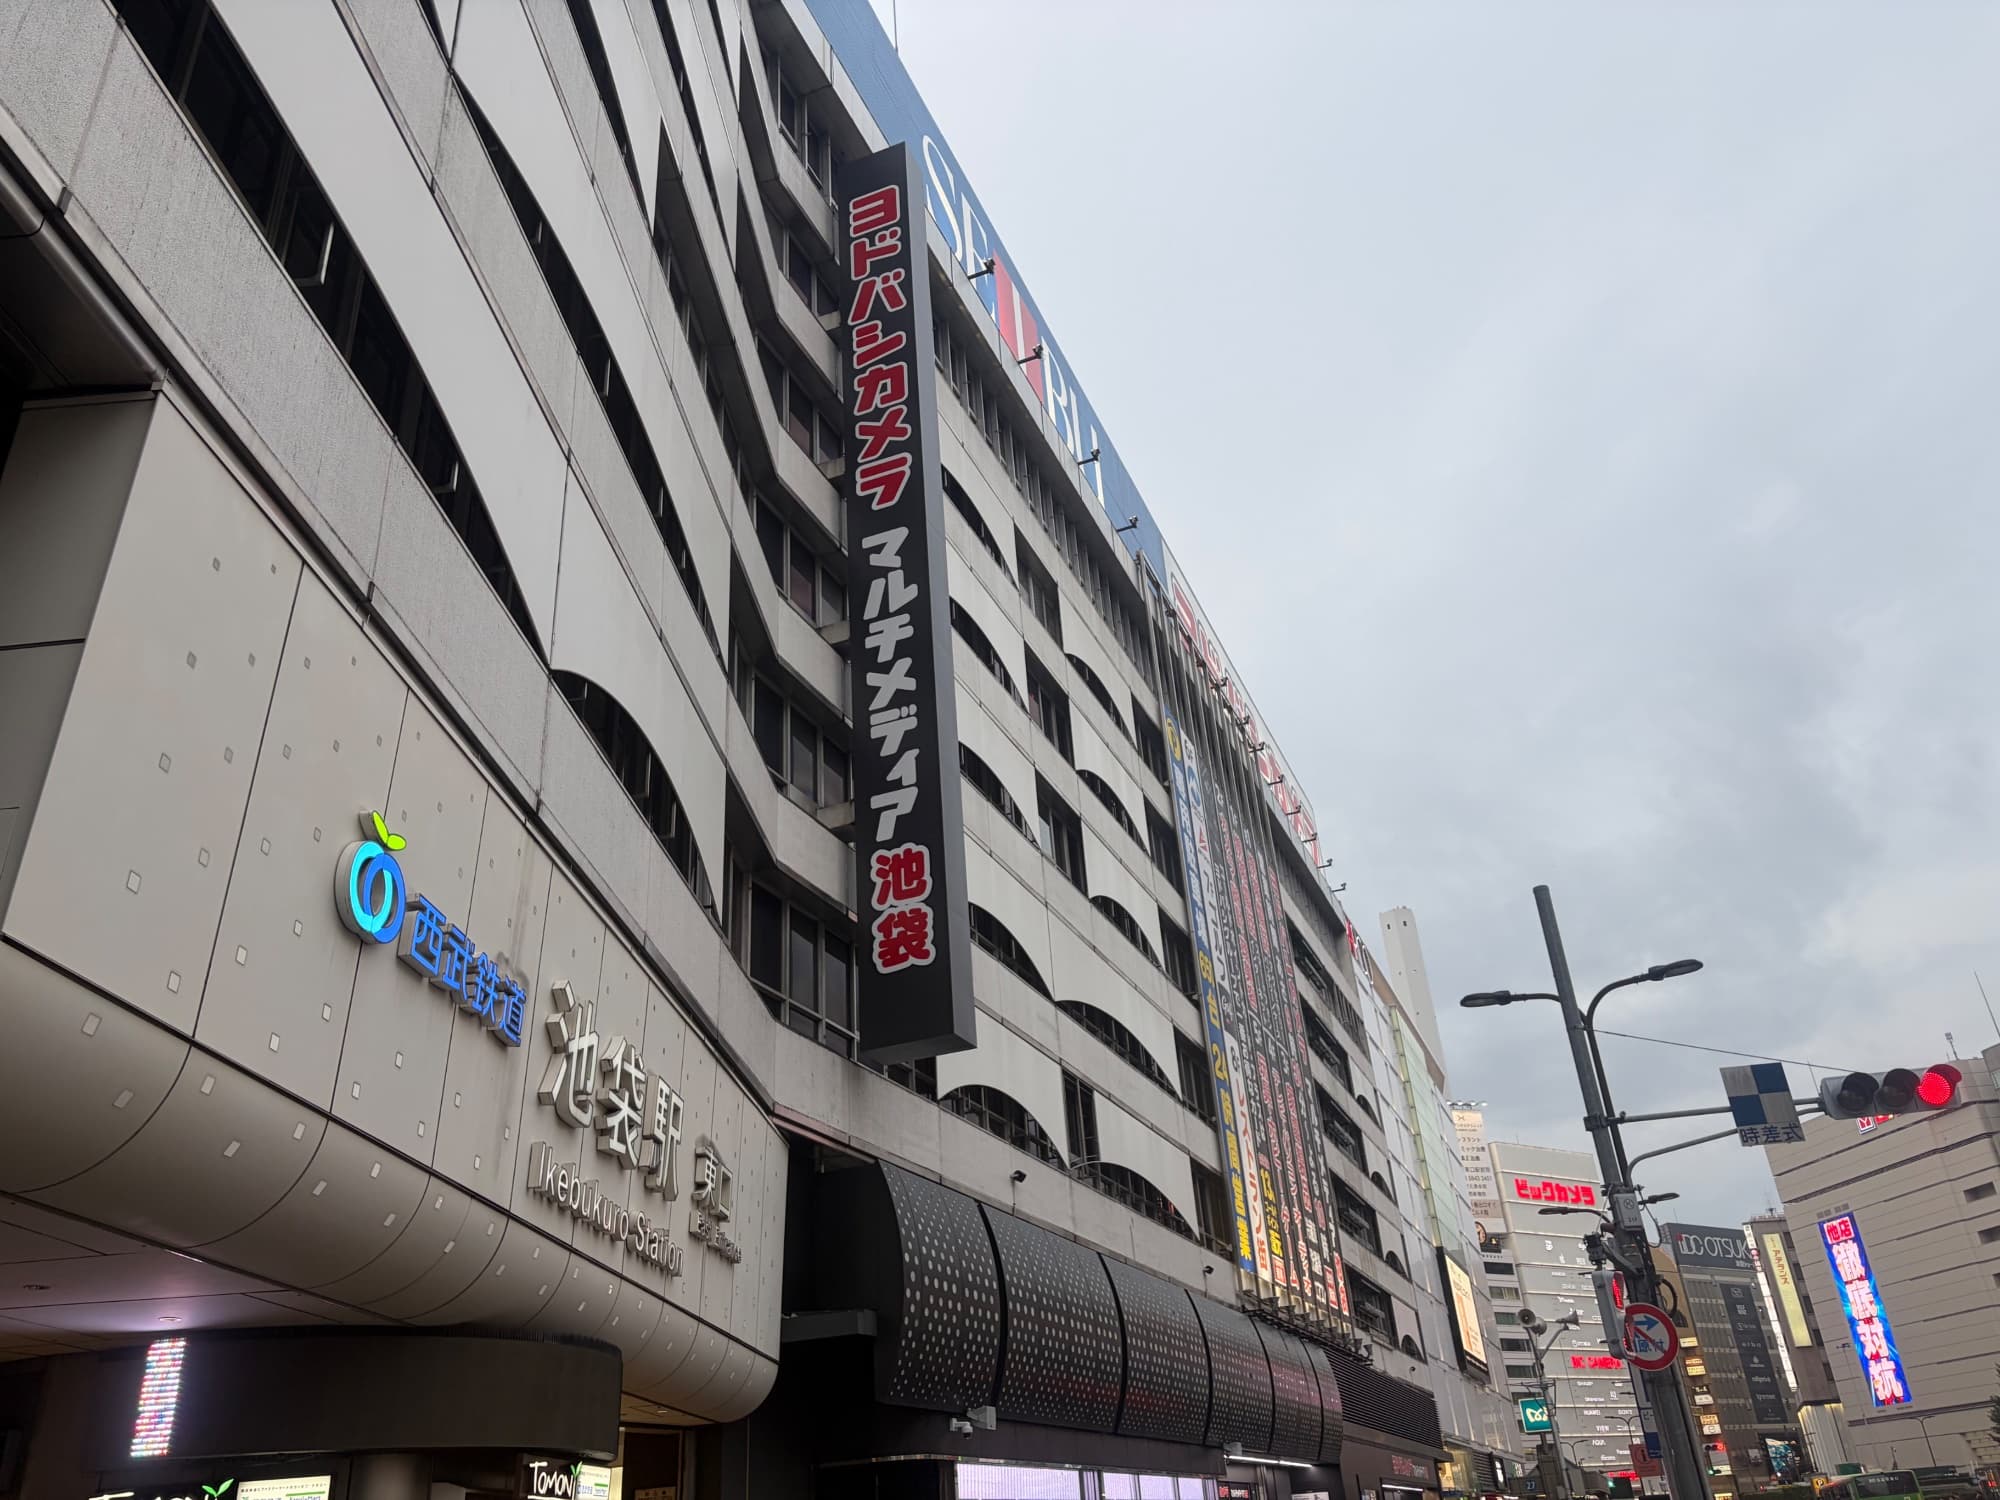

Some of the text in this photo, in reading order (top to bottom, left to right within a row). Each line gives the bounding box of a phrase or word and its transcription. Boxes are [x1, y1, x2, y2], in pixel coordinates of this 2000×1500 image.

[849, 184, 912, 510] ヨドバシカメラ
[862, 527, 918, 842] マルチメディア
[408, 894, 527, 1047] 西武鉄道
[870, 843, 936, 974] 池袋
[538, 980, 684, 1201] 池袋駅
[1740, 1122, 1803, 1145] 時差式
[529, 1141, 684, 1277] Ikebukuro Station
[692, 1146, 733, 1220] 東口
[1514, 1178, 1595, 1207] ビックカメラ
[1704, 1236, 1753, 1259] OTSUK
[1826, 1219, 1852, 1242] 他店
[1832, 1240, 1904, 1400] 徹底対抗
